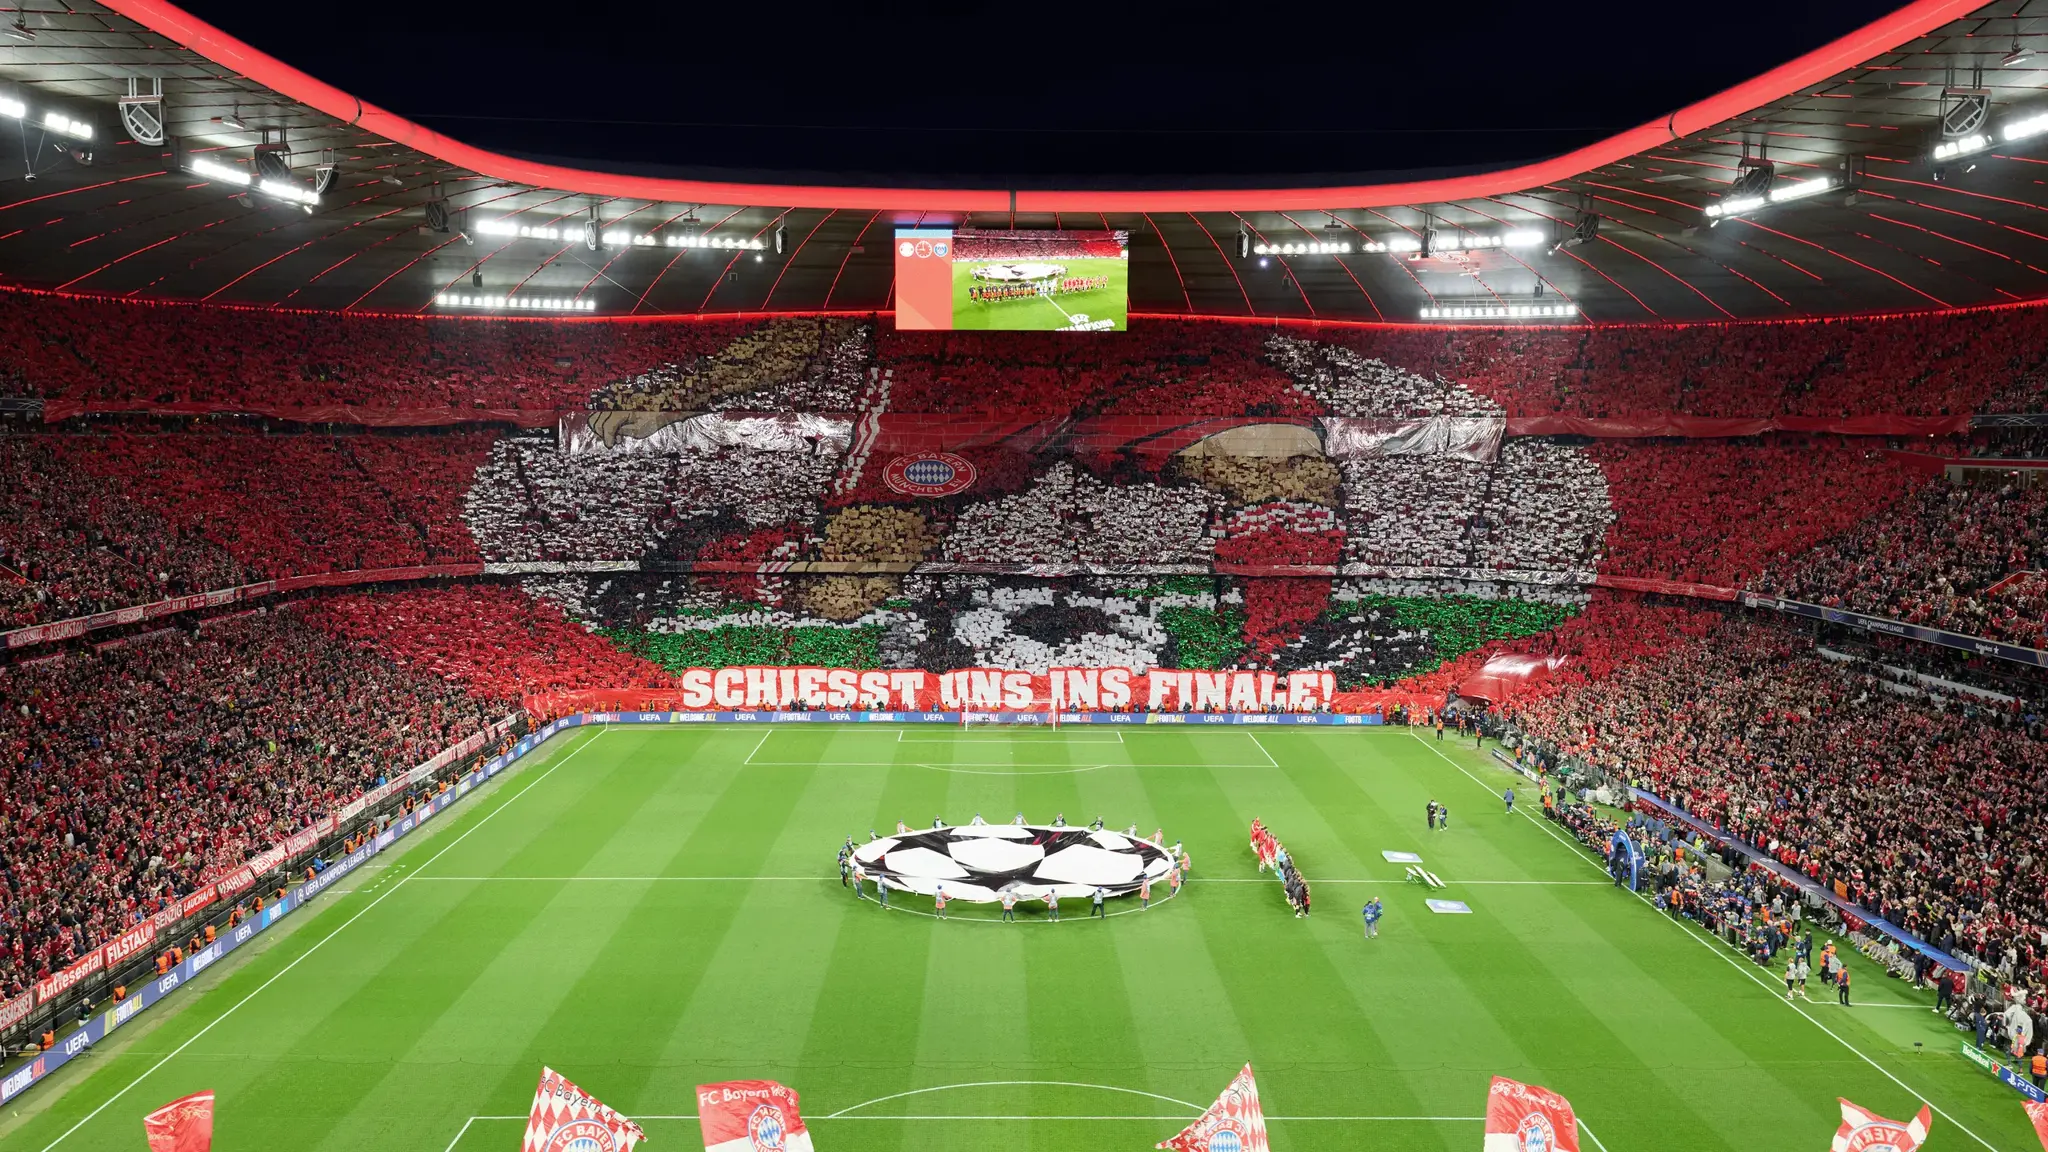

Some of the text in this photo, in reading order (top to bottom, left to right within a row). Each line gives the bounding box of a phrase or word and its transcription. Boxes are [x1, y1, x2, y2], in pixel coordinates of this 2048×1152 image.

[918, 452, 968, 472] BAYERN
[1867, 620, 1889, 631] CHAMPIONS
[1889, 625, 1904, 633] LEAGUE
[682, 668, 1335, 712] SCHIESST UNS INS FINALE!
[639, 713, 661, 722] UEFA
[679, 713, 717, 722] WELCOME ALL
[734, 713, 757, 722] UEFA
[829, 713, 850, 722] UEFA
[868, 712, 894, 721] WELCOME
[923, 713, 944, 722] UEFA
[1017, 713, 1038, 722] UEFA
[1081, 713, 1092, 722] ALL
[1110, 715, 1131, 723] UEFA
[1203, 715, 1224, 723] UEFA
[1243, 714, 1279, 724] WELCOME ALL
[1296, 716, 1317, 724] UEFA
[305, 849, 366, 896] UEFA CHAMPIONS LEAGUE
[154, 903, 183, 932] SENZIG
[235, 923, 252, 943] UEFA
[106, 928, 148, 964] FILSTAL
[158, 972, 179, 993] UEFA
[65, 1030, 90, 1055] UEFA
[1962, 1043, 1990, 1069] Heineken
[1, 1056, 46, 1100] WELCOME ALL
[555, 1083, 602, 1114] Bayern
[699, 1091, 719, 1107] FC
[722, 1088, 770, 1102] Bayern
[2017, 1079, 2038, 1099] PS5
[554, 1129, 574, 1148] FC
